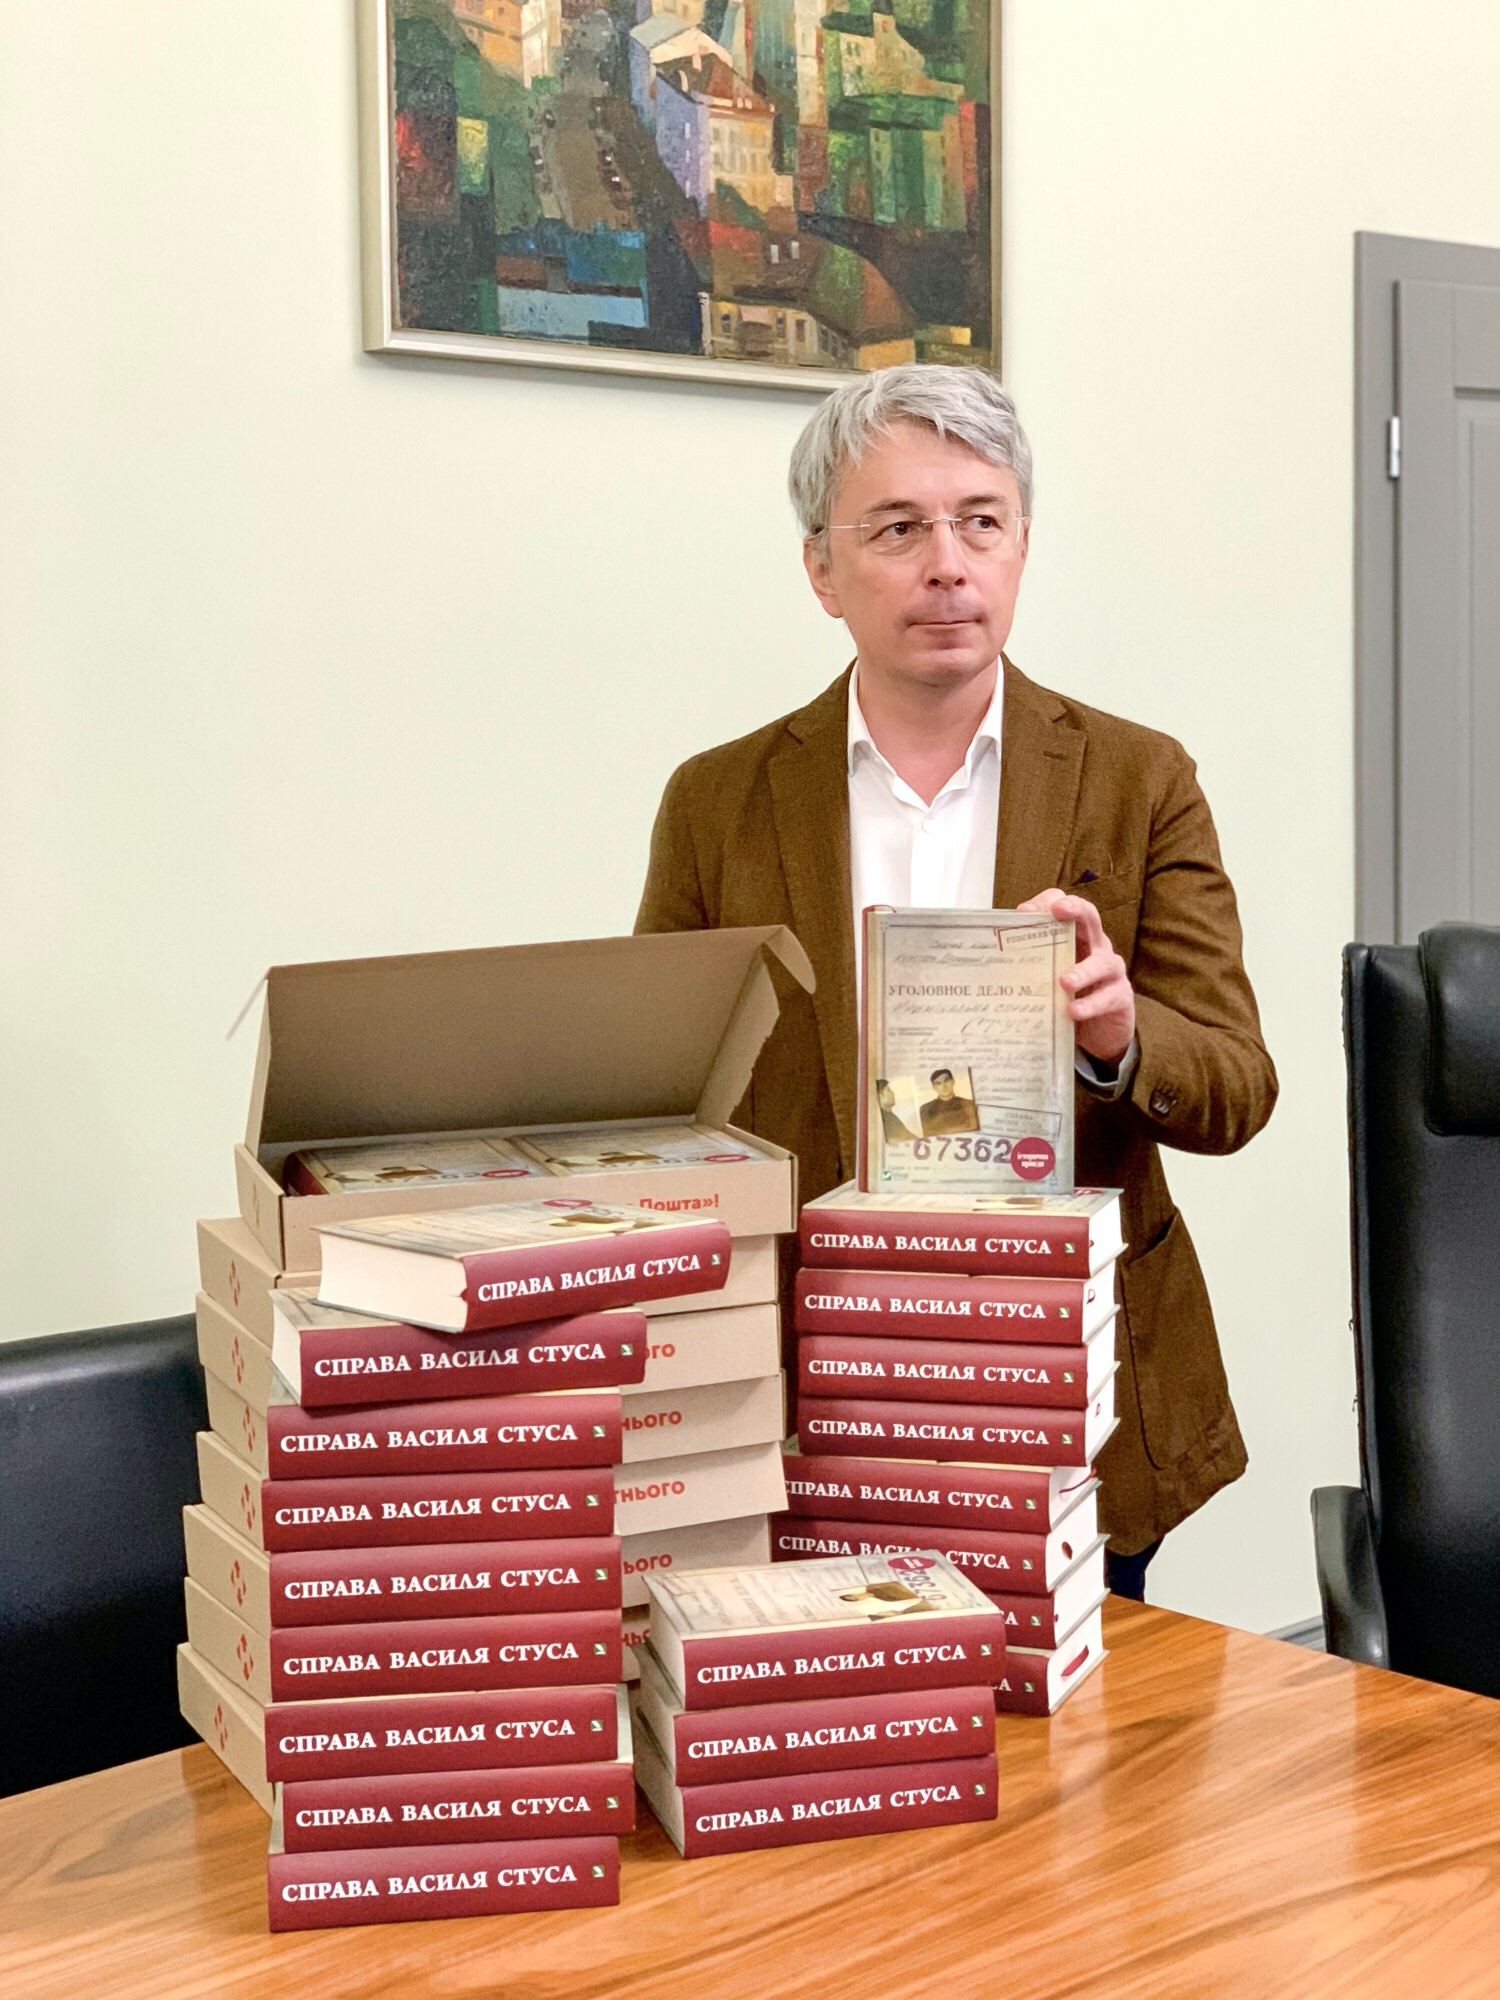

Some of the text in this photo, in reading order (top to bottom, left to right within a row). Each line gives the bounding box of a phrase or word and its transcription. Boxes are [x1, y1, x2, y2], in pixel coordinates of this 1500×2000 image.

[888, 985, 971, 997] УГОЛОВНОЕ
[976, 985, 1013, 998] ДЕЛО
[913, 1136, 1012, 1164] 67362
[810, 1233, 1052, 1255] СПРАВА ВАСИЛЯ СТУСА
[477, 1254, 701, 1302] СПРАВА ВАСИЛЯ СТУСА
[804, 1294, 1047, 1319] СПРАВА ВАСИЛЯ СТУСА
[314, 1343, 606, 1377] СПРАВА ВАСИЛЯ СТУСА
[808, 1359, 1051, 1384] СПРАВА ВАСИЛЯ СТУСА
[280, 1424, 578, 1453] СПРАВА ВАСИЛЯ СТУСА
[808, 1419, 1050, 1445] СПРАВА ВАСИЛЯ СТУСА
[275, 1493, 572, 1526] СПРАВА ВАСИЛЯ СТУСА
[859, 1485, 940, 1505] ВАСИЛЯ
[947, 1491, 1014, 1510] СТУСА
[779, 1536, 853, 1555] СПРАВА
[945, 1550, 1011, 1570] СТУСА
[284, 1567, 581, 1600] СПРАВА ВАСИЛЯ СТУСА
[283, 1642, 579, 1675] СПРАВА ВАСИЛЯ СТУСА
[697, 1644, 967, 1684] СПРАВА ВАСИЛЯ СТУСА
[279, 1719, 576, 1754] СПРАВА ВАСИЛЯ СТУСА
[687, 1716, 959, 1759] СПРАВА ВАСИЛЯ СТУСА
[295, 1796, 591, 1828] СПРАВА ВАСИЛЯ СТУСА
[695, 1785, 962, 1833] СПРАВА ВАСИЛЯ СТУСА
[281, 1865, 578, 1903] СПРАВА ВАСИЛЯ СТУСА
